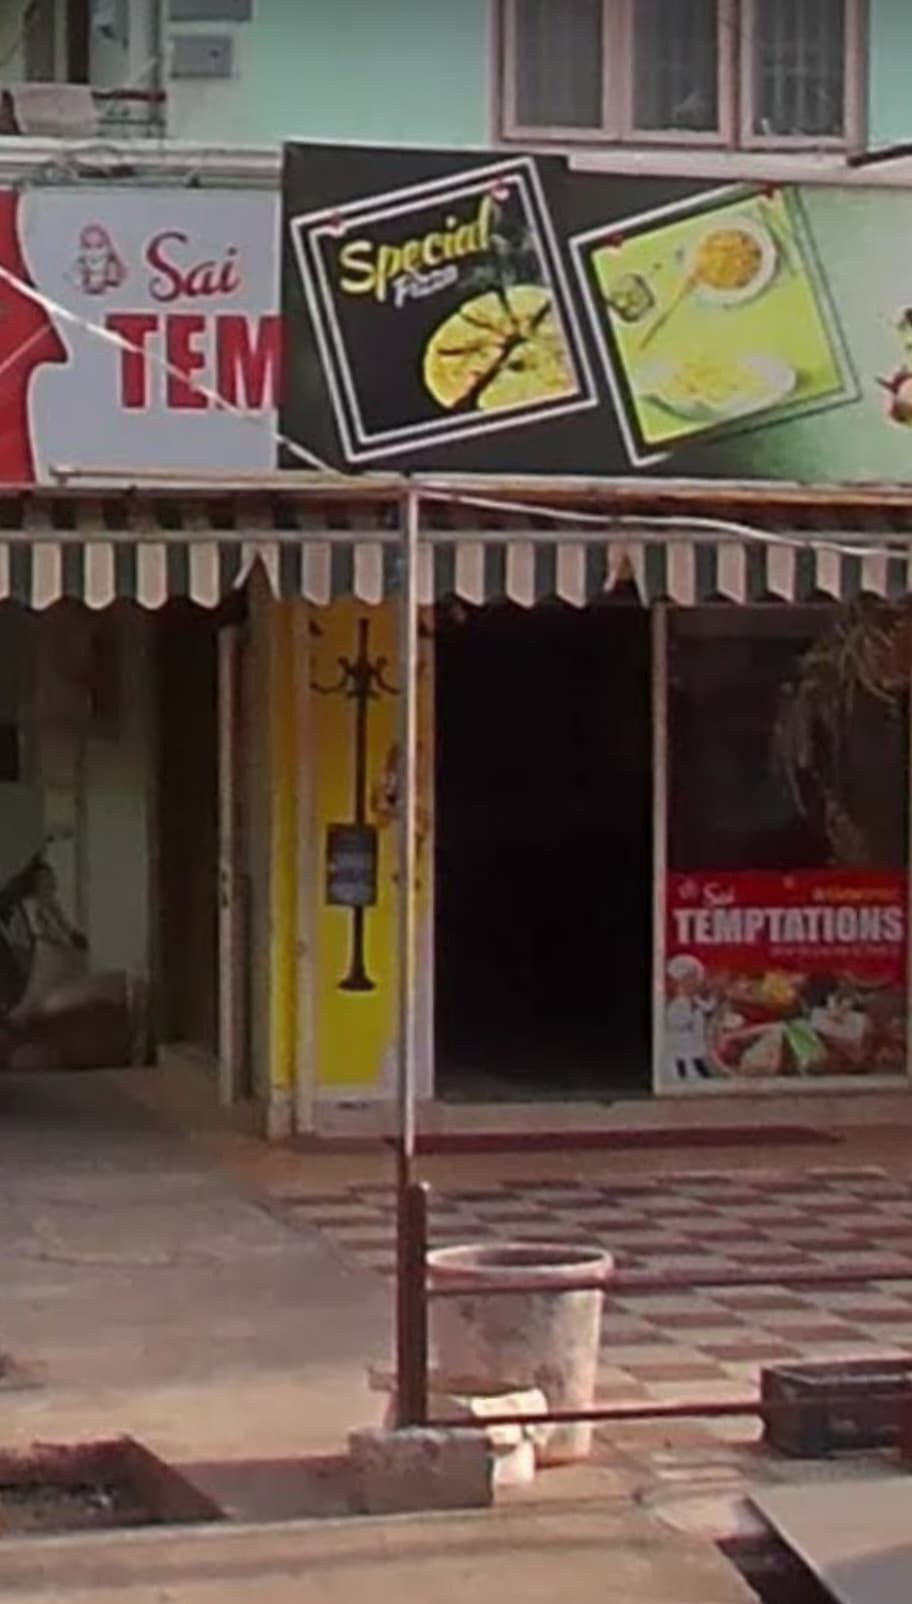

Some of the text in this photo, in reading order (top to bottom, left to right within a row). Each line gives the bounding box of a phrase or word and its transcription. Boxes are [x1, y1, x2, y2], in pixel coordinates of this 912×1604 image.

[146, 231, 239, 301] Sai
[339, 195, 490, 302] Special
[106, 314, 281, 410] TEM
[674, 906, 905, 944] TEMPTATIONS
